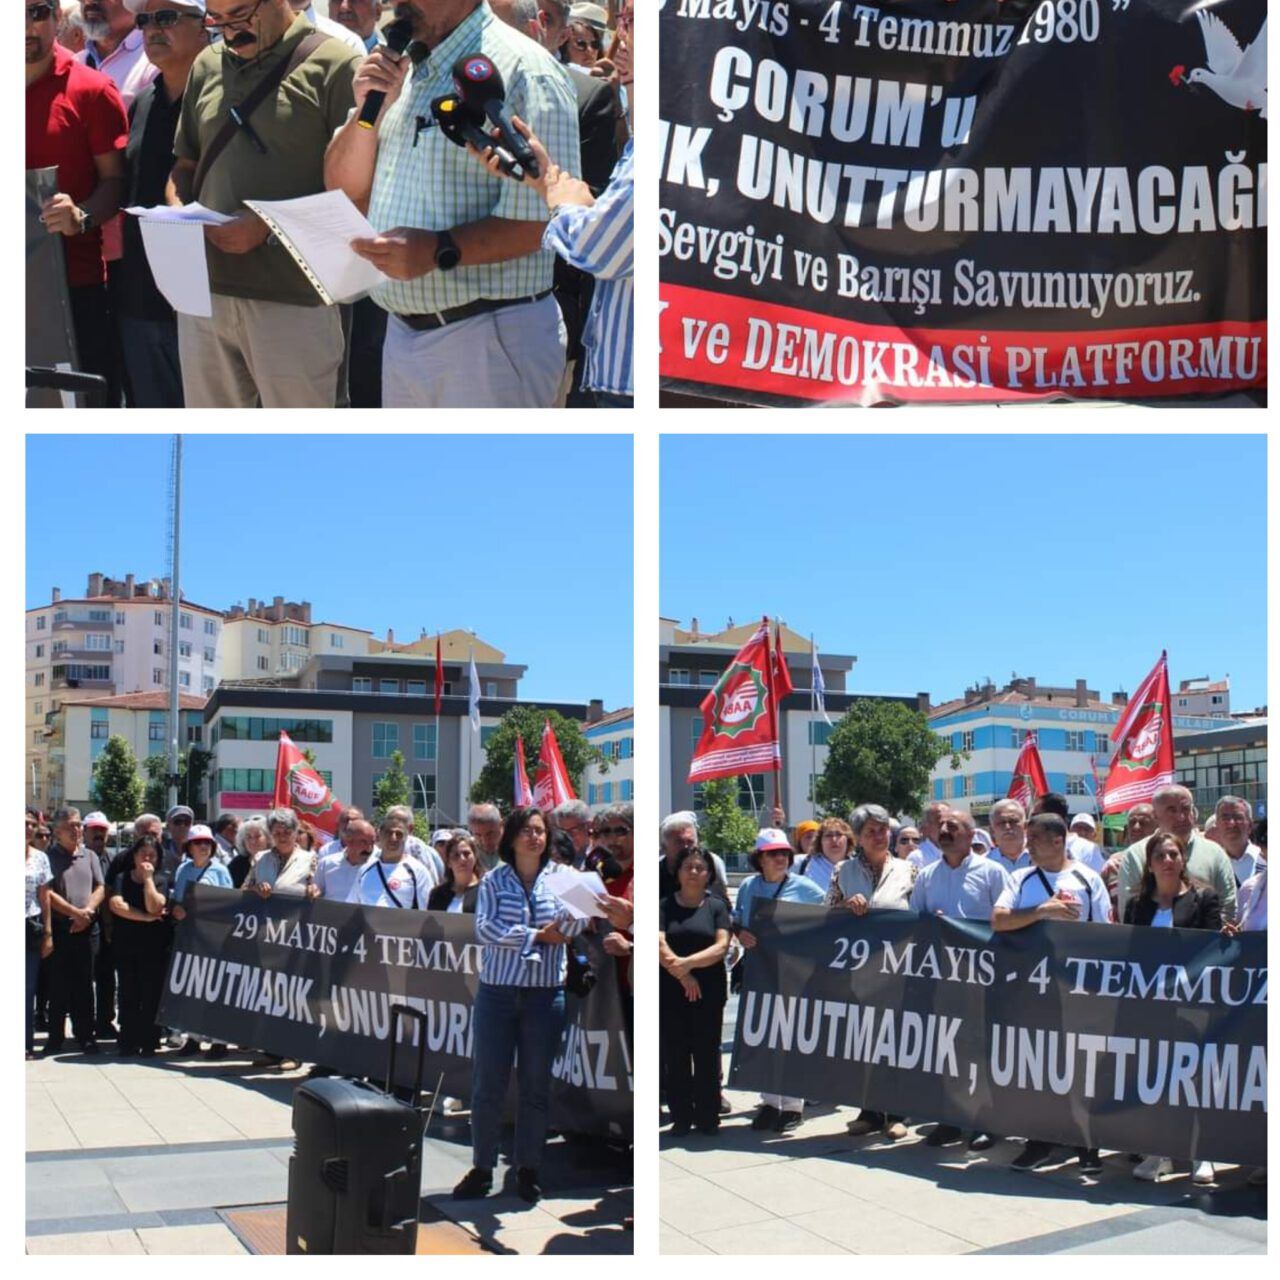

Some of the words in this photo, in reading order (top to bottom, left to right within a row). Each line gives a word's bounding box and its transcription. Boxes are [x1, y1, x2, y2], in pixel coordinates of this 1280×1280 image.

[817, 6, 842, 46] 4
[852, 3, 1014, 59] Temmuz
[658, 207, 785, 282] Sevgiyi
[793, 251, 828, 294] ve
[837, 253, 943, 316] Barışı
[952, 258, 1203, 319] Savunuyoruz.
[681, 317, 731, 367] ve
[741, 317, 995, 390] DEMOKRASİ
[1003, 335, 1262, 390] PLATFORMU
[232, 912, 260, 941] 29
[263, 915, 339, 957] MAYIS
[352, 937, 369, 965] 4
[828, 935, 870, 971] 29
[881, 939, 996, 987] MAYIS
[1028, 962, 1052, 995] 4
[168, 950, 315, 1026] UNUTMADIK
[741, 990, 963, 1079] UNUTMADIK
